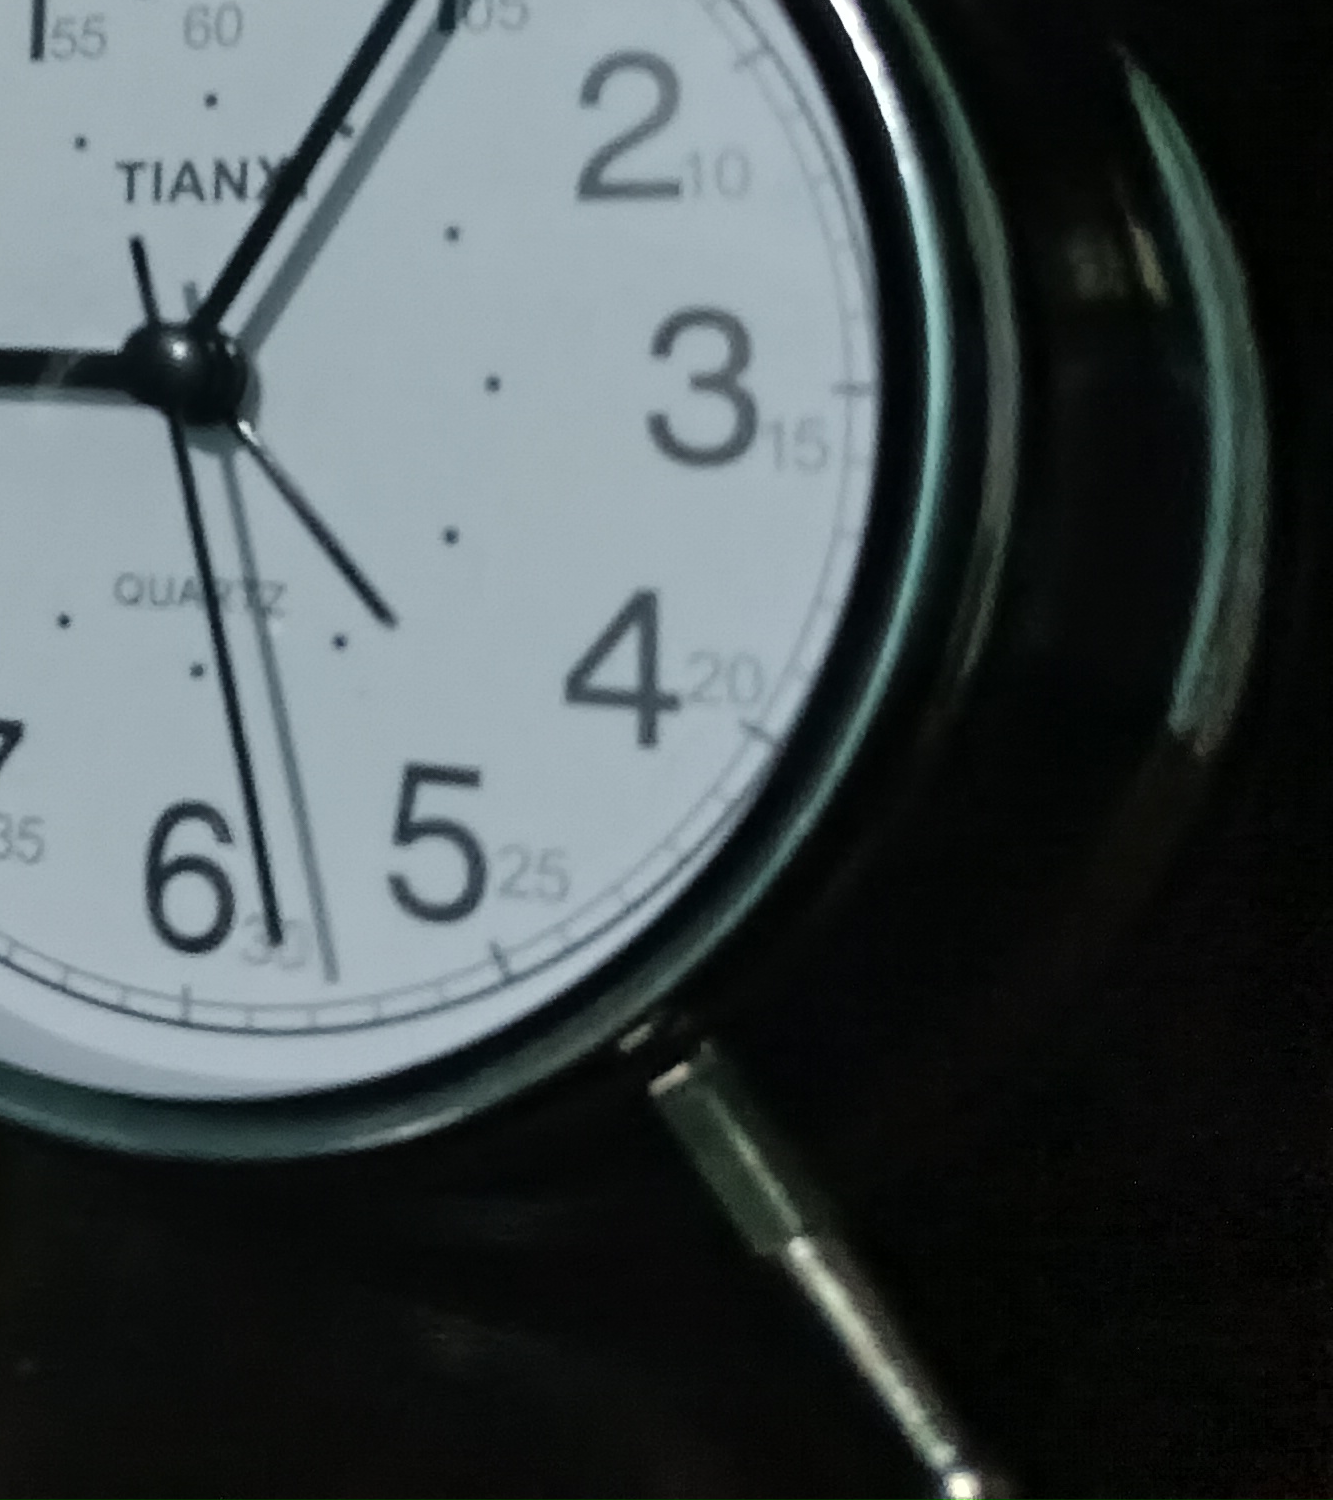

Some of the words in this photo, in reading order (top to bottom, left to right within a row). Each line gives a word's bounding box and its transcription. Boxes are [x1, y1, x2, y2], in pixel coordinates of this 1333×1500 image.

[50, 15, 109, 61] 55
[182, 3, 244, 51] 60
[577, 49, 682, 200] 2
[686, 148, 751, 199] 10
[645, 305, 758, 470] 3
[764, 416, 829, 474] 15
[563, 585, 683, 751] 4
[684, 649, 765, 707] 20
[387, 760, 489, 925] 5
[497, 841, 573, 902] 25
[145, 798, 235, 956] 6
